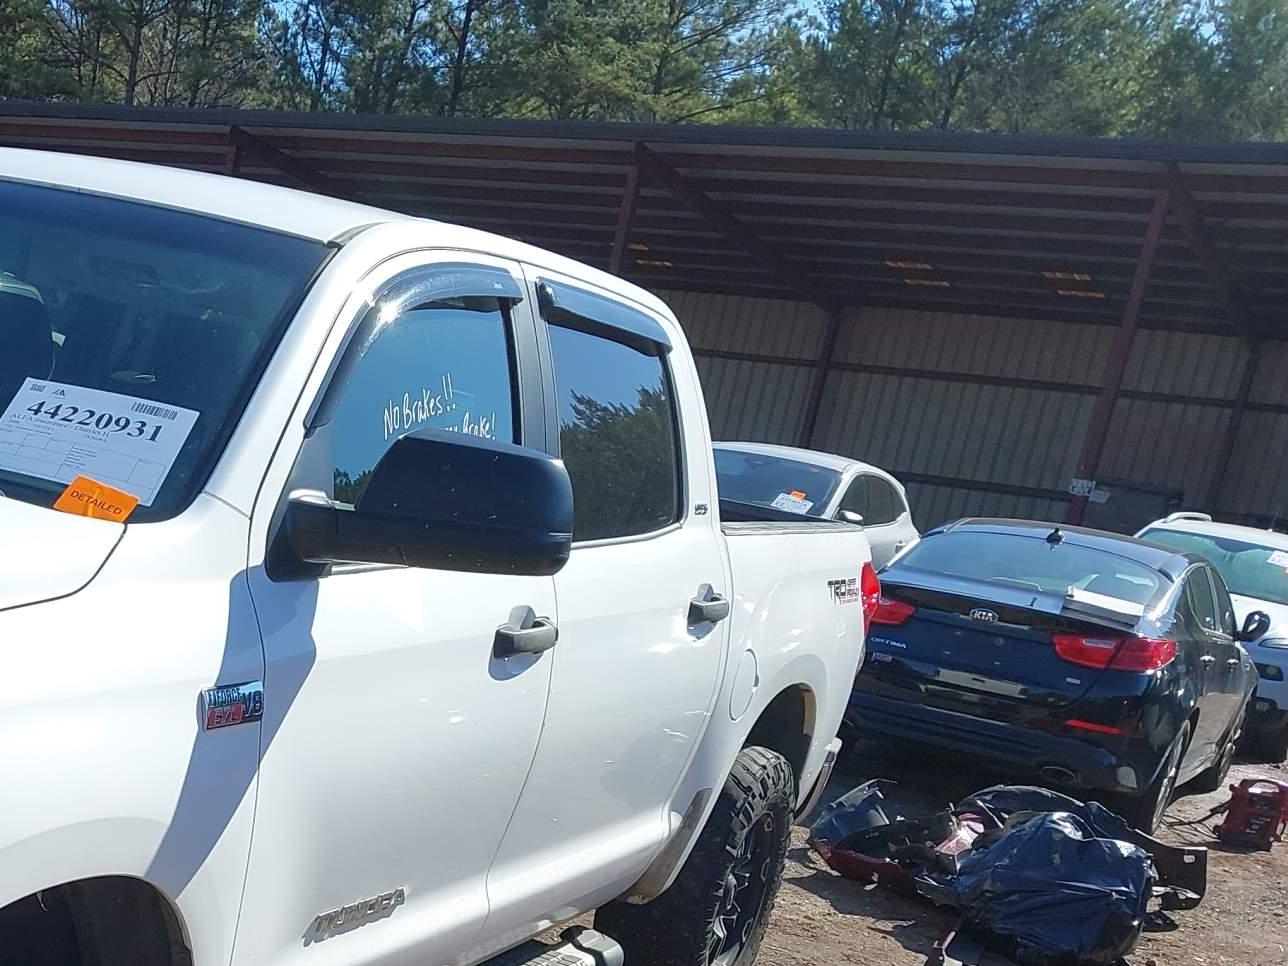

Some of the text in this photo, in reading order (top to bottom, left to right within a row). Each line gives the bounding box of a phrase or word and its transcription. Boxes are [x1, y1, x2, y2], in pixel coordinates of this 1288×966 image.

[26, 400, 164, 444] 44220931
[70, 490, 123, 516] DETAILED
[973, 610, 994, 622] KIA
